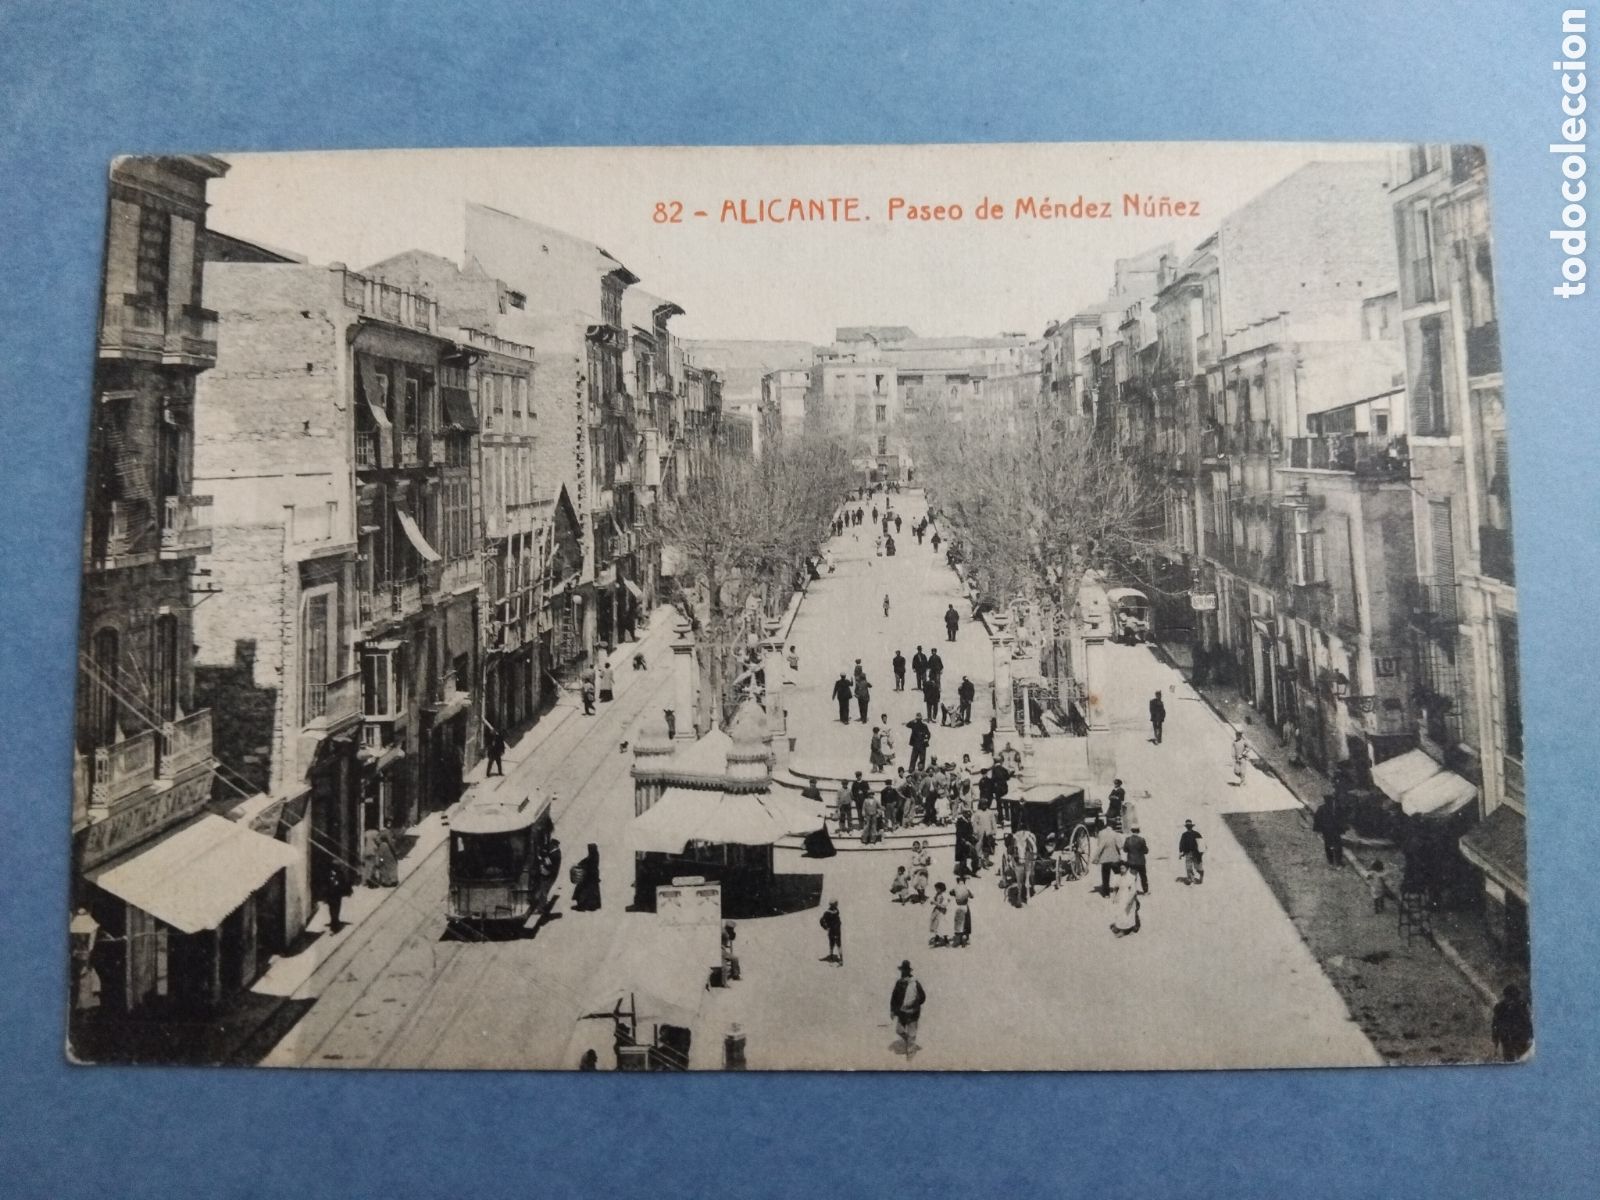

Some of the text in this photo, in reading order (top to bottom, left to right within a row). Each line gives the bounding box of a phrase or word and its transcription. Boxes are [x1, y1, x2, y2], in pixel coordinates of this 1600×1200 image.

[652, 200, 684, 224] 82
[719, 196, 871, 224] ALICANTE.
[887, 197, 963, 221] Paseo
[974, 198, 1005, 220] de
[1013, 195, 1112, 219] Méndez
[1122, 194, 1201, 217] Núñez
